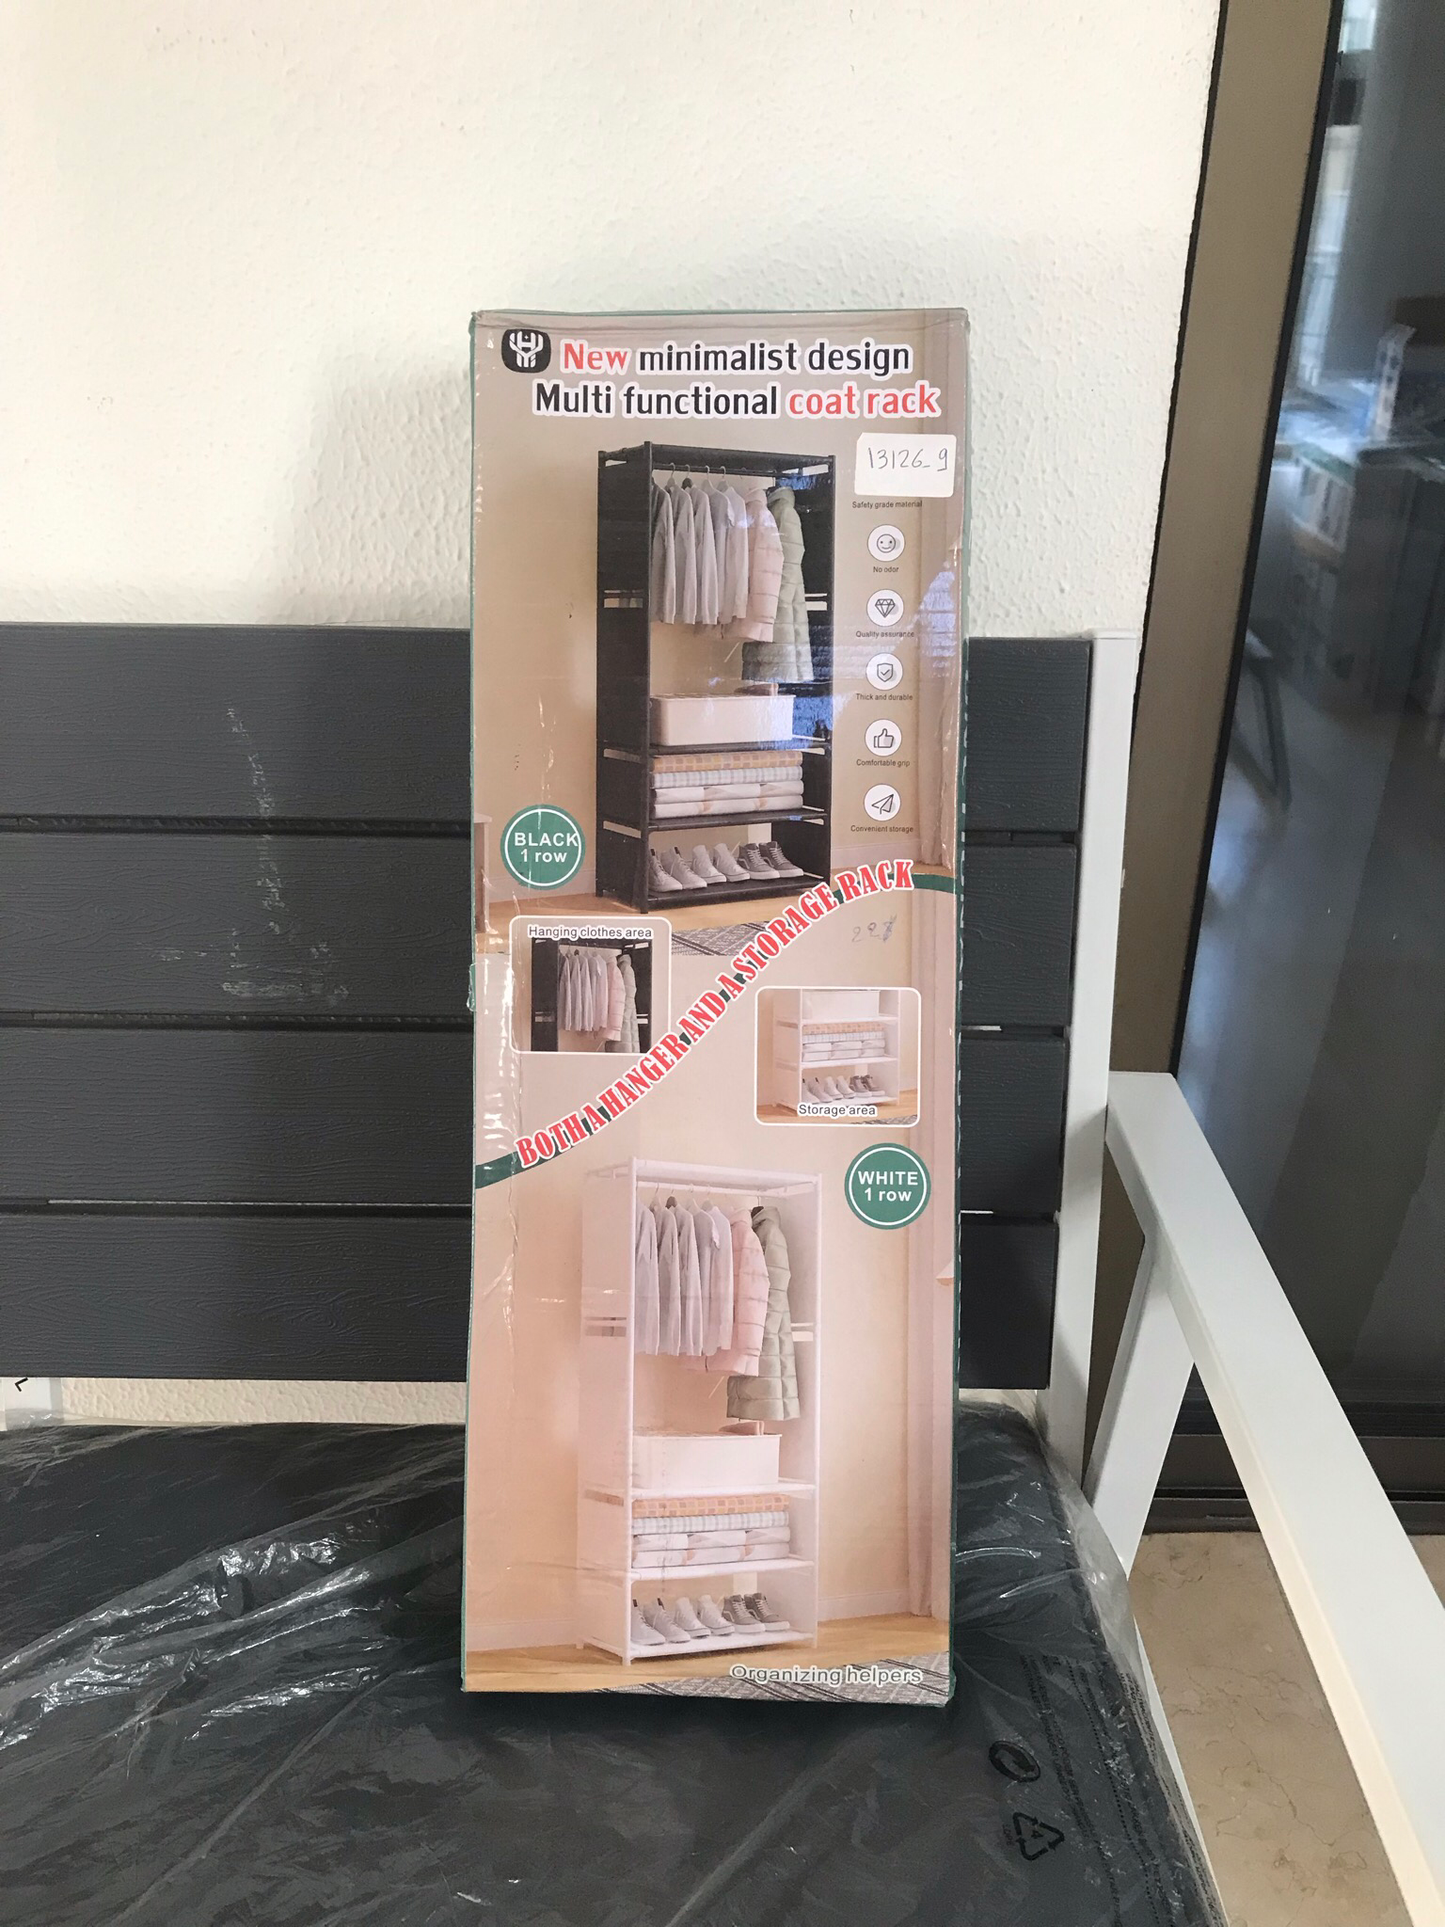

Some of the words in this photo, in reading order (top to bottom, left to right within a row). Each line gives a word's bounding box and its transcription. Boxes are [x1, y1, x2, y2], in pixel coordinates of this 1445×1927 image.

[563, 342, 629, 371] New
[639, 342, 798, 372] minimalist
[807, 341, 910, 377] design
[535, 382, 613, 414] Multi
[622, 385, 778, 415] functional
[788, 385, 857, 416] coat
[866, 384, 938, 415] rack
[852, 501, 873, 509] Safety
[895, 500, 923, 508] material
[855, 630, 880, 639] Quality
[881, 630, 915, 638] assurance
[855, 693, 873, 701] Thick
[874, 693, 887, 701] and
[888, 693, 914, 701] durable
[856, 759, 896, 767] Comfortable
[897, 760, 911, 768] grip
[850, 825, 888, 833] Convenient
[888, 826, 914, 834] storage
[513, 832, 579, 847] BLACK
[520, 848, 529, 863] 1
[534, 851, 568, 863] row
[528, 925, 581, 940] Hanging
[580, 926, 623, 938] clothes
[625, 928, 653, 938] area
[515, 1113, 589, 1167] BOTH
[582, 1104, 607, 1132] A
[598, 1033, 689, 1119] HANGER
[678, 991, 727, 1042] AND
[717, 973, 745, 999] A
[732, 884, 838, 981] STORAGE
[836, 860, 914, 902] RACK
[798, 1103, 846, 1118] Storage
[848, 1106, 877, 1115] area
[857, 1170, 919, 1186] WHITE
[864, 1187, 872, 1202] 1
[878, 1190, 913, 1202] row
[731, 1664, 842, 1685] Organizing
[846, 1666, 923, 1685] helpers
